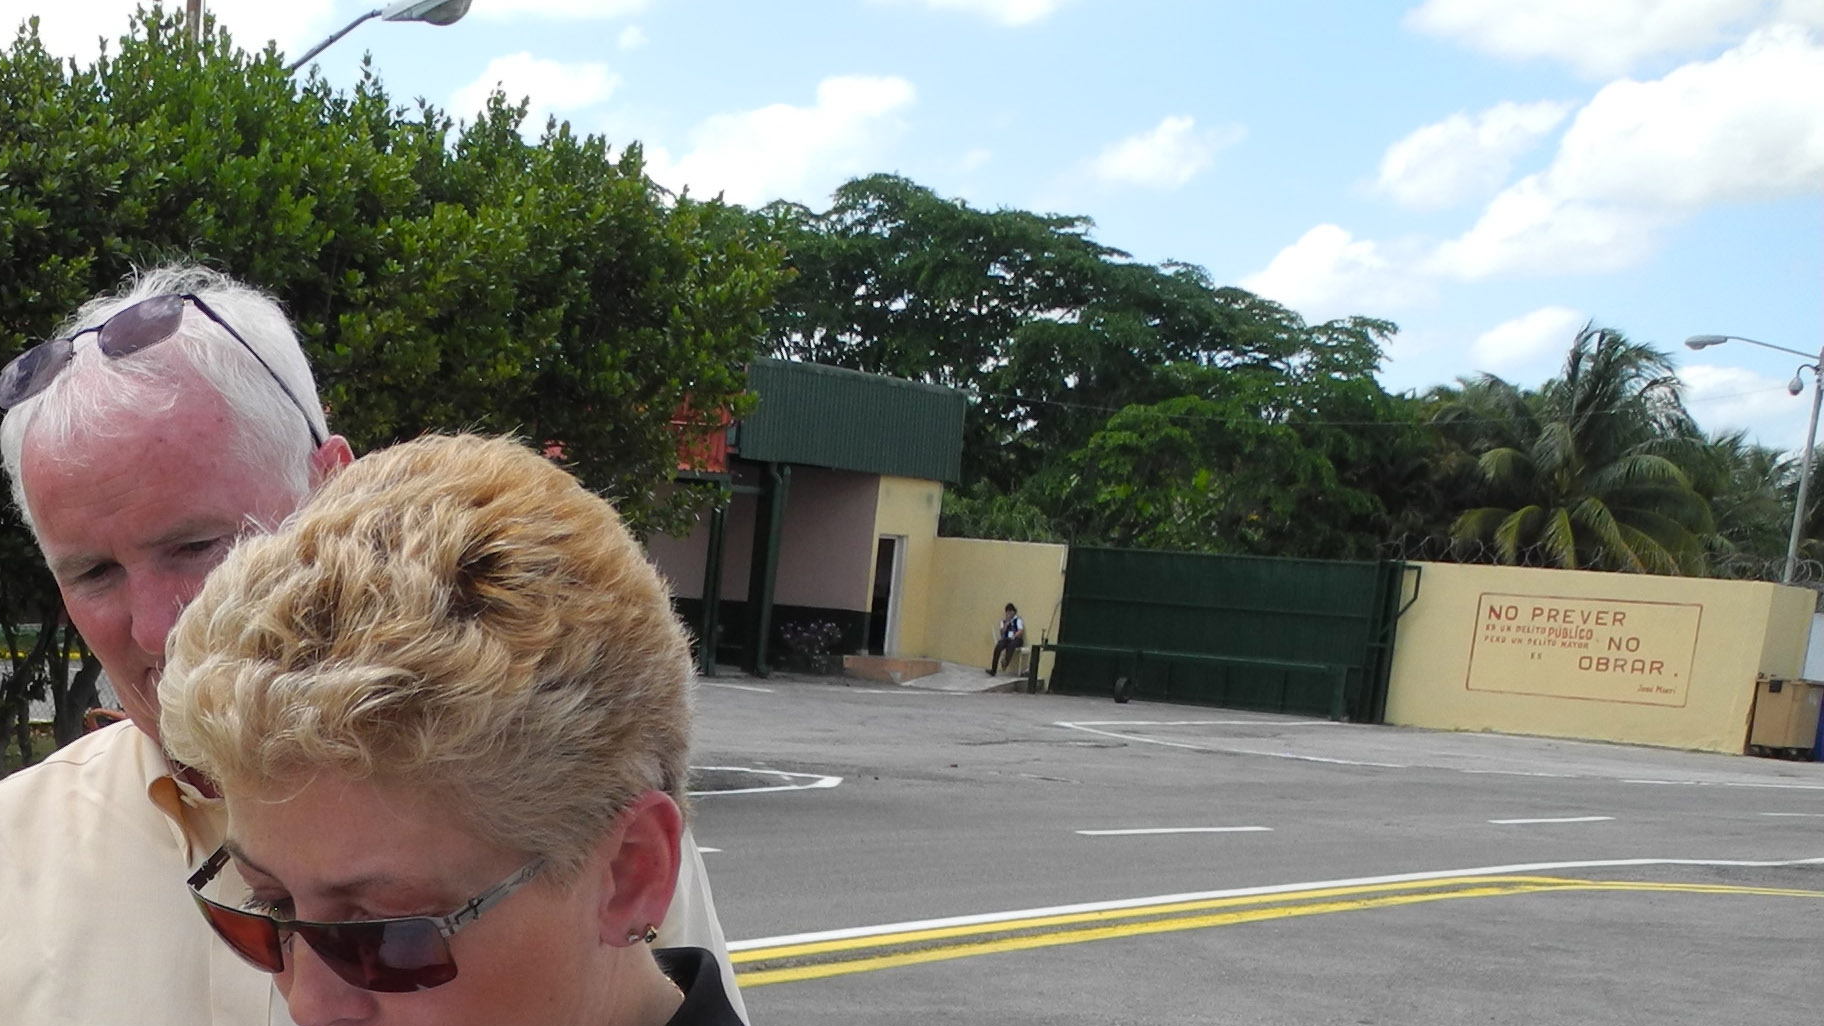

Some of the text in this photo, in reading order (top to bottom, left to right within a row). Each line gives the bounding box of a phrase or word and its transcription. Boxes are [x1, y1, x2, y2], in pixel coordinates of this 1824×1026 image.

[1487, 604, 1627, 627] NO PREVER
[1607, 636, 1642, 653] NO
